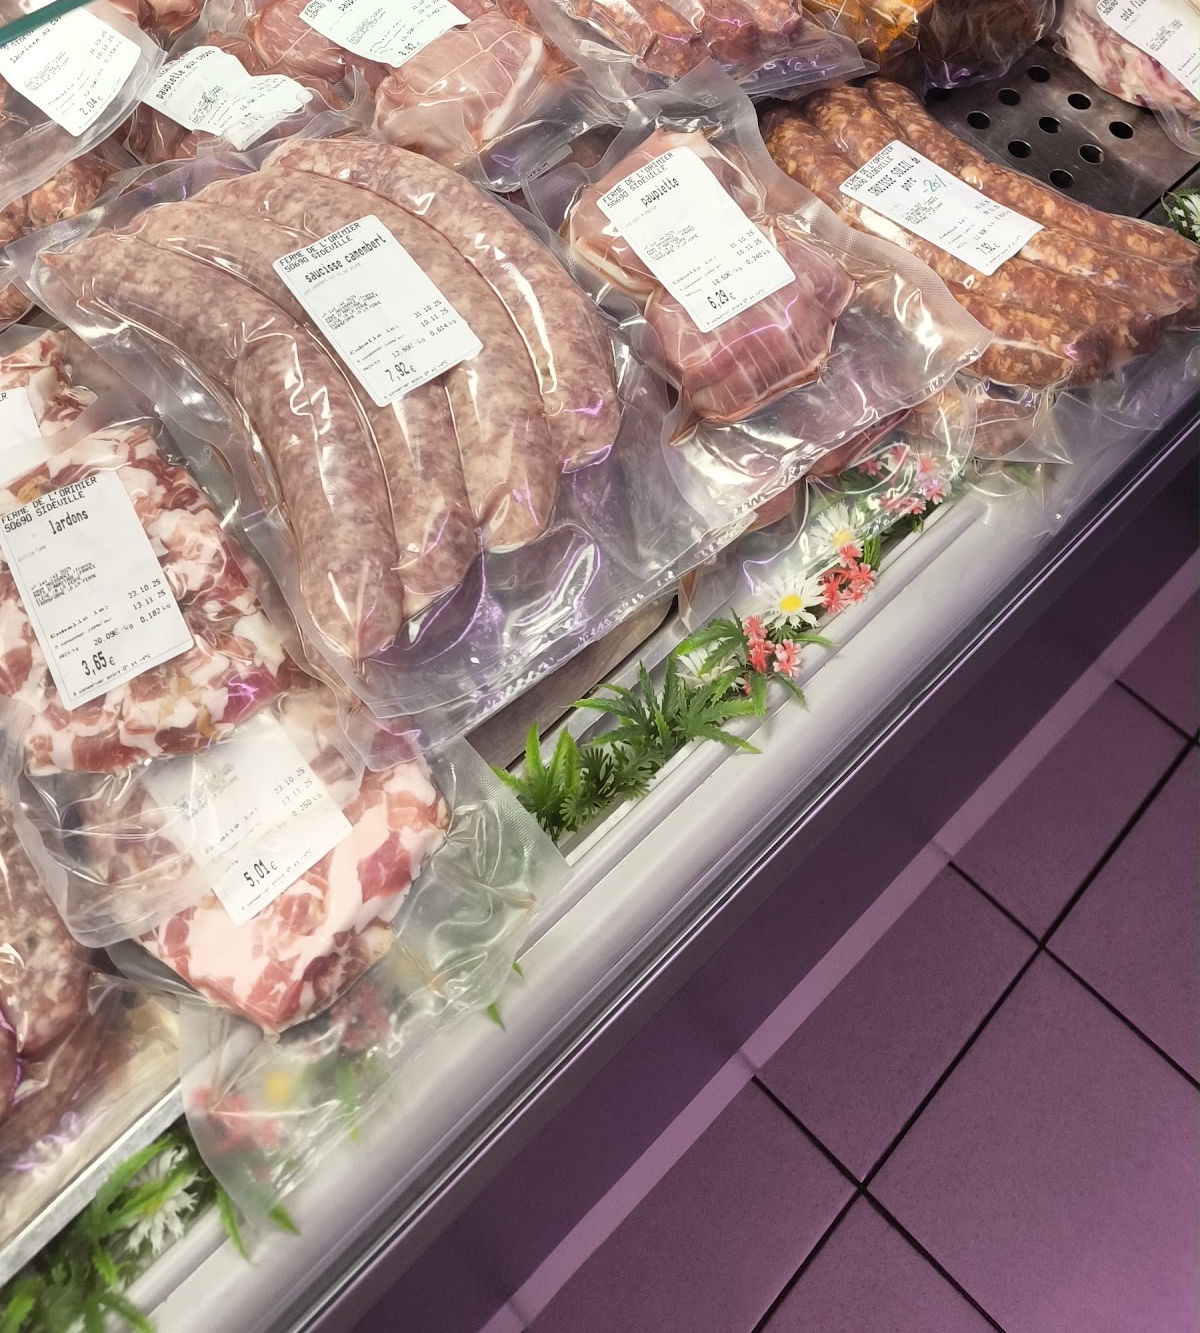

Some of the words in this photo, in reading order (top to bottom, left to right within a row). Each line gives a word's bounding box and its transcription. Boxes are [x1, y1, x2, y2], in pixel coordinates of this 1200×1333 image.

[1120, 7, 1135, 22] cote
[156, 69, 186, 100] paupiette
[602, 187, 625, 204] FERME
[625, 176, 636, 186] DE
[637, 152, 674, 177] L'ORIMIER
[607, 191, 629, 209] 50690
[630, 165, 667, 192] SIDEVILLE
[641, 176, 680, 207] paupiette
[279, 252, 302, 267] FERME
[305, 244, 318, 255] DE
[319, 222, 361, 249] L'ORIMIER
[284, 256, 309, 273] 50690
[311, 235, 353, 260] SIDEVILLE
[305, 259, 343, 283] saucisse
[344, 233, 387, 263] camembert
[706, 289, 736, 309] 6,29€
[421, 308, 449, 328] 10.11.25
[384, 361, 417, 383] 7,92€
[1, 504, 31, 525] FERME
[33, 495, 46, 509] DE
[48, 476, 98, 502] L'ORIMIER
[4, 512, 35, 533] 50690
[36, 490, 86, 518] SIDEVILLE
[49, 509, 89, 535] lardons
[127, 578, 162, 600] 23.10.25
[132, 590, 166, 611] 13.11.25
[81, 651, 116, 677] 3,65€
[243, 859, 278, 887] 5,01€
